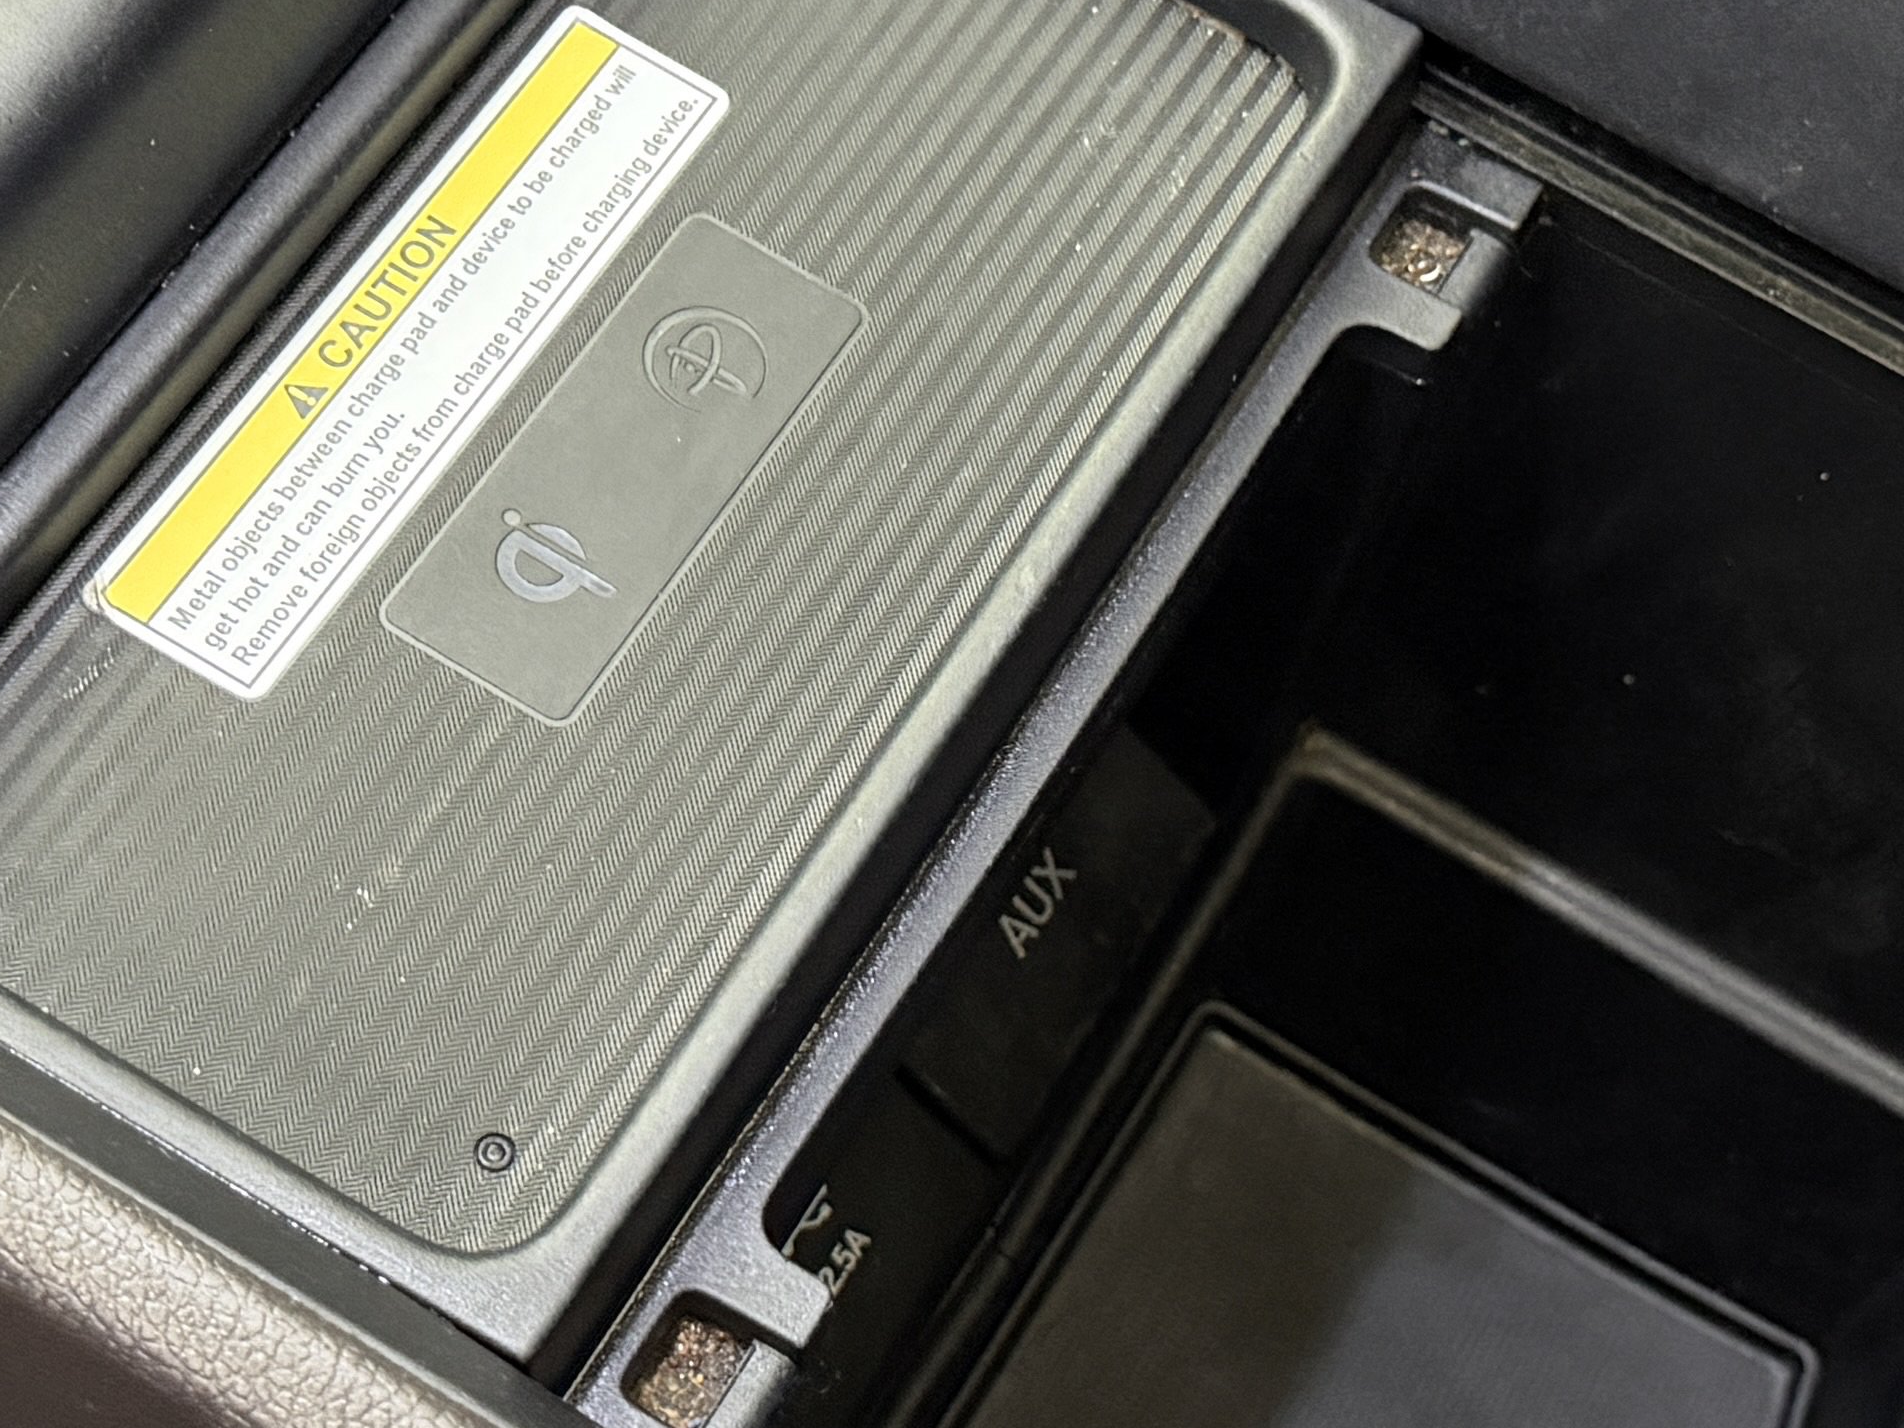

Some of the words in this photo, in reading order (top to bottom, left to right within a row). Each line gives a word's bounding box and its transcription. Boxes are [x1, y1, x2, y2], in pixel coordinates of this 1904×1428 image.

[168, 570, 226, 630] Metal
[225, 502, 284, 560] objects
[273, 420, 352, 501] between
[348, 355, 405, 416] charge
[400, 312, 437, 355] pad
[433, 274, 467, 313] and
[462, 218, 515, 275] device
[507, 196, 532, 215] to
[523, 171, 552, 194] be
[550, 95, 611, 168] charged
[605, 64, 637, 94] will
[231, 585, 308, 666] Remove
[299, 515, 365, 582] foreign
[361, 443, 421, 511] objects
[412, 398, 458, 442] from
[454, 333, 509, 395] charge
[505, 292, 539, 333] pad
[530, 237, 586, 293] before
[583, 157, 652, 232] charging
[643, 99, 698, 156] device.
[318, 215, 456, 367] CAUTION
[205, 613, 239, 651] get
[228, 577, 269, 612] hot
[263, 535, 300, 576] and
[296, 500, 332, 535] can
[322, 453, 369, 497] burn
[363, 414, 405, 454] you.
[997, 846, 1078, 960] AUX
